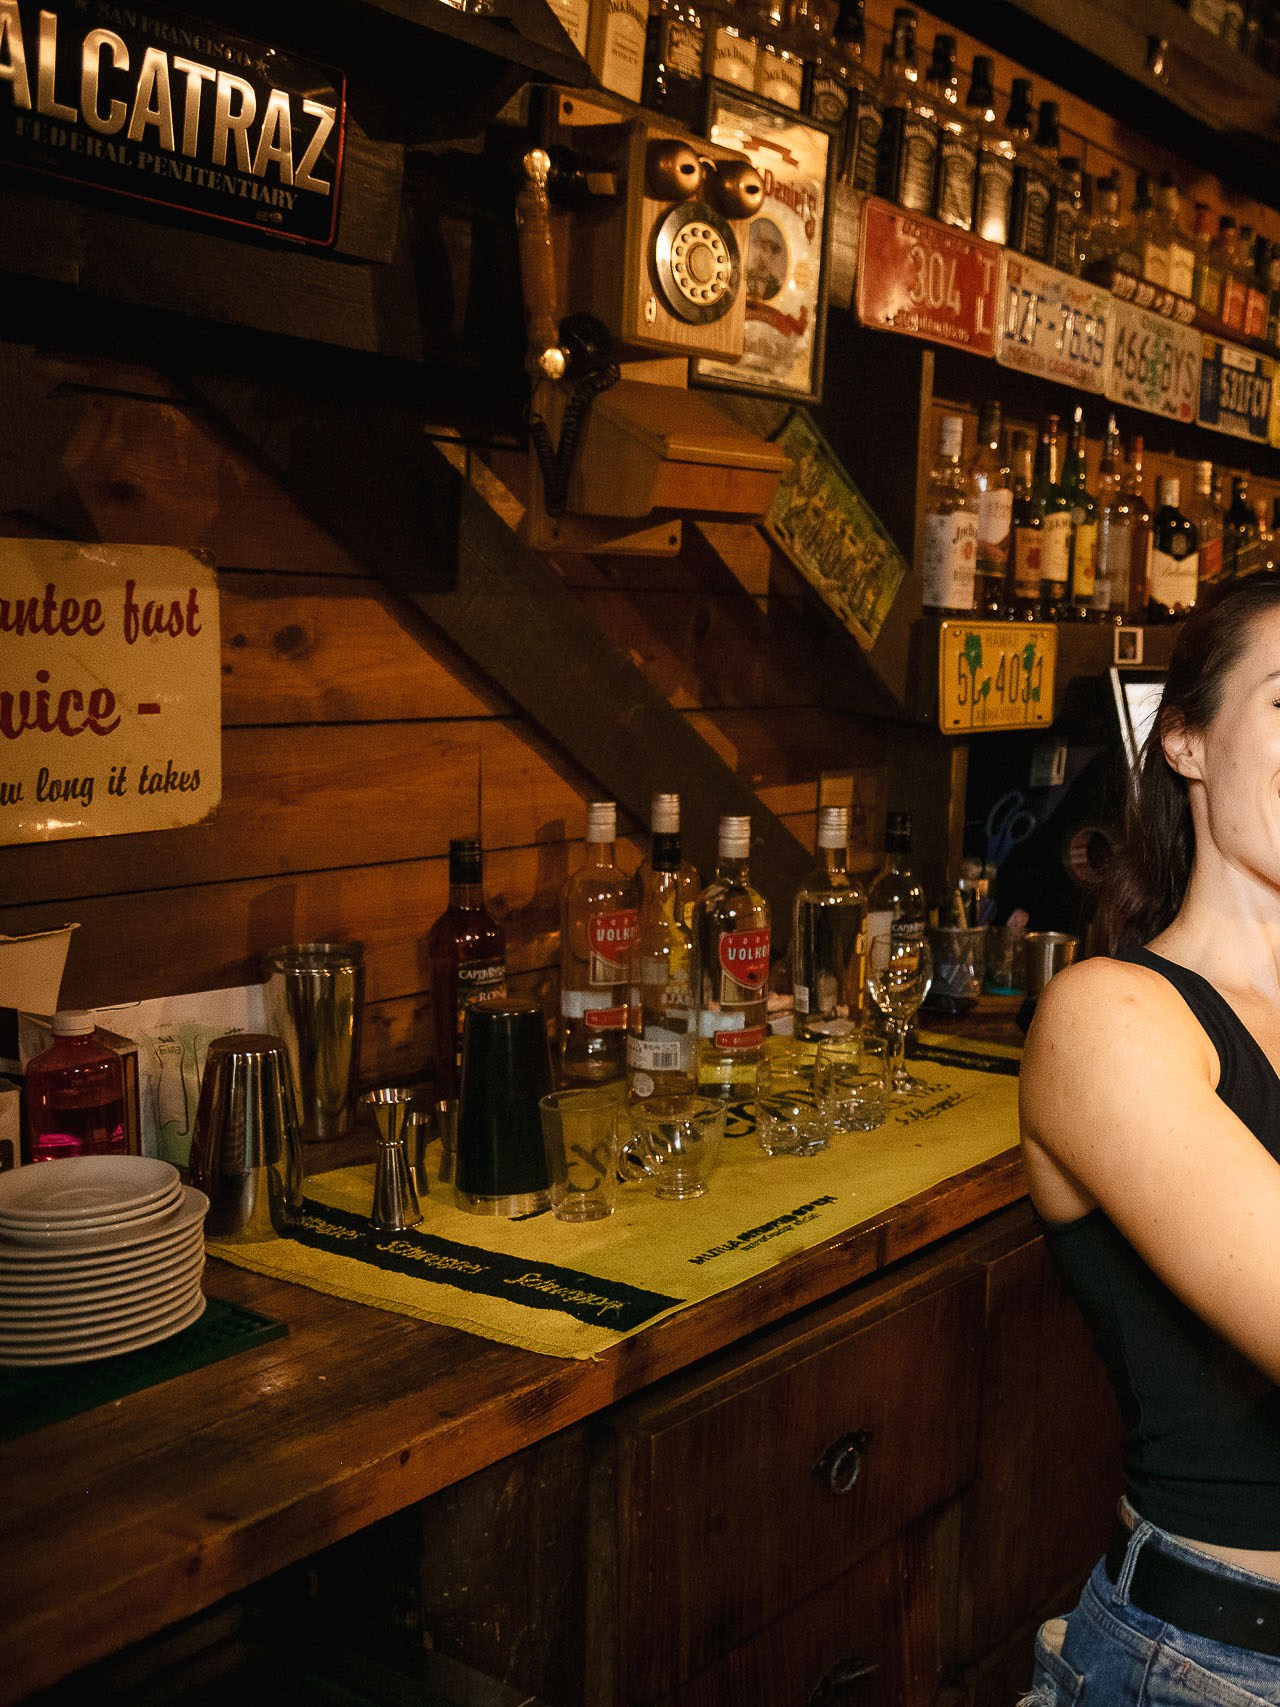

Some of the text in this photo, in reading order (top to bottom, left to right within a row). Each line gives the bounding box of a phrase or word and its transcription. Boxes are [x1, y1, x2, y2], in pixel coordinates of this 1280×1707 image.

[0, 0, 337, 196] ALCATRAZ
[15, 115, 299, 210] FEDERAL PENITENTIARY
[908, 245, 962, 316] 304
[124, 579, 202, 645] fast
[36, 767, 95, 808] long
[108, 766, 127, 796] it
[138, 760, 201, 796] takes
[728, 945, 769, 961] VOLKO
